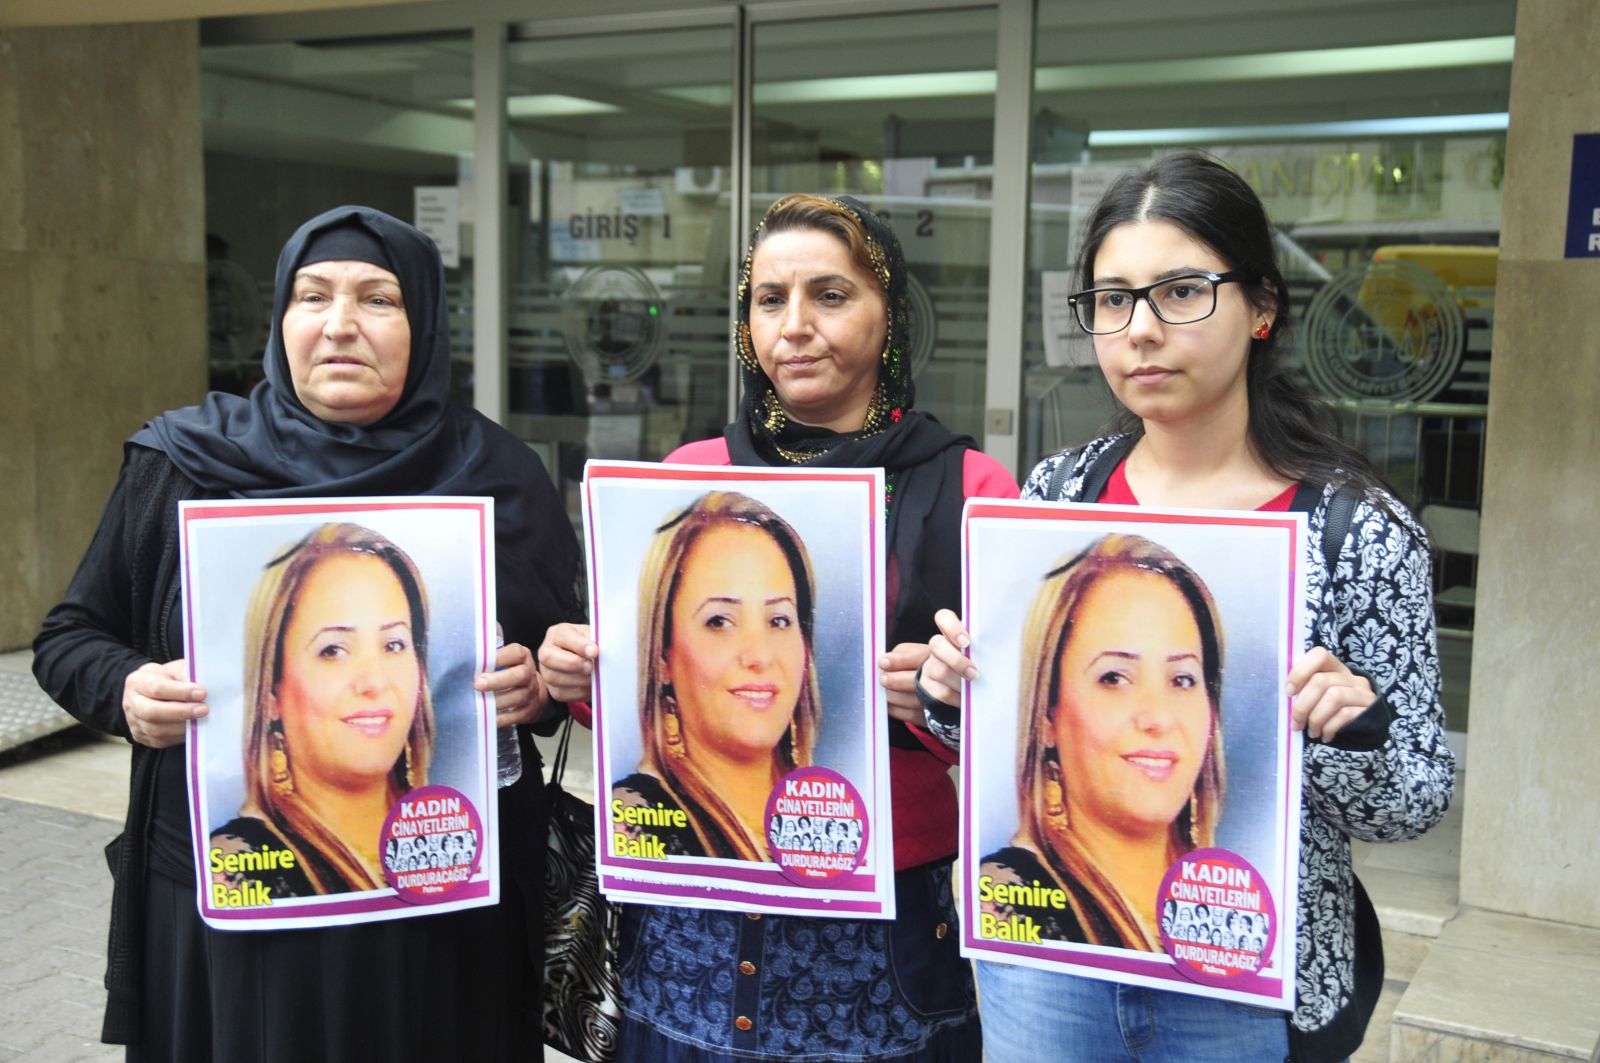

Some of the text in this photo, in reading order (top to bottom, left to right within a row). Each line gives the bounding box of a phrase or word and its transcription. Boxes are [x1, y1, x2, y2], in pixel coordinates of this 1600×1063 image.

[569, 205, 639, 246] GİRİŞ
[915, 209, 935, 238] 2
[785, 779, 845, 799] KADIN
[400, 797, 461, 819] KADIN
[612, 799, 687, 828] Semire
[776, 796, 855, 817] CİNAYETLERİNİ
[391, 811, 469, 837] CİNAYETLERİNİ
[209, 843, 295, 874] Semire
[614, 832, 668, 861] Balık
[780, 852, 855, 871] DURDURACAĞIZ
[1181, 861, 1251, 889] KADIN
[397, 866, 470, 889] DURDURACAĞIZ
[212, 879, 273, 909] Balık
[978, 875, 1067, 910] Semire
[1170, 879, 1261, 911] CİNAYETLERİNİ
[980, 912, 1042, 945] Balık
[1174, 942, 1258, 972] DURDURACAĞIZ
